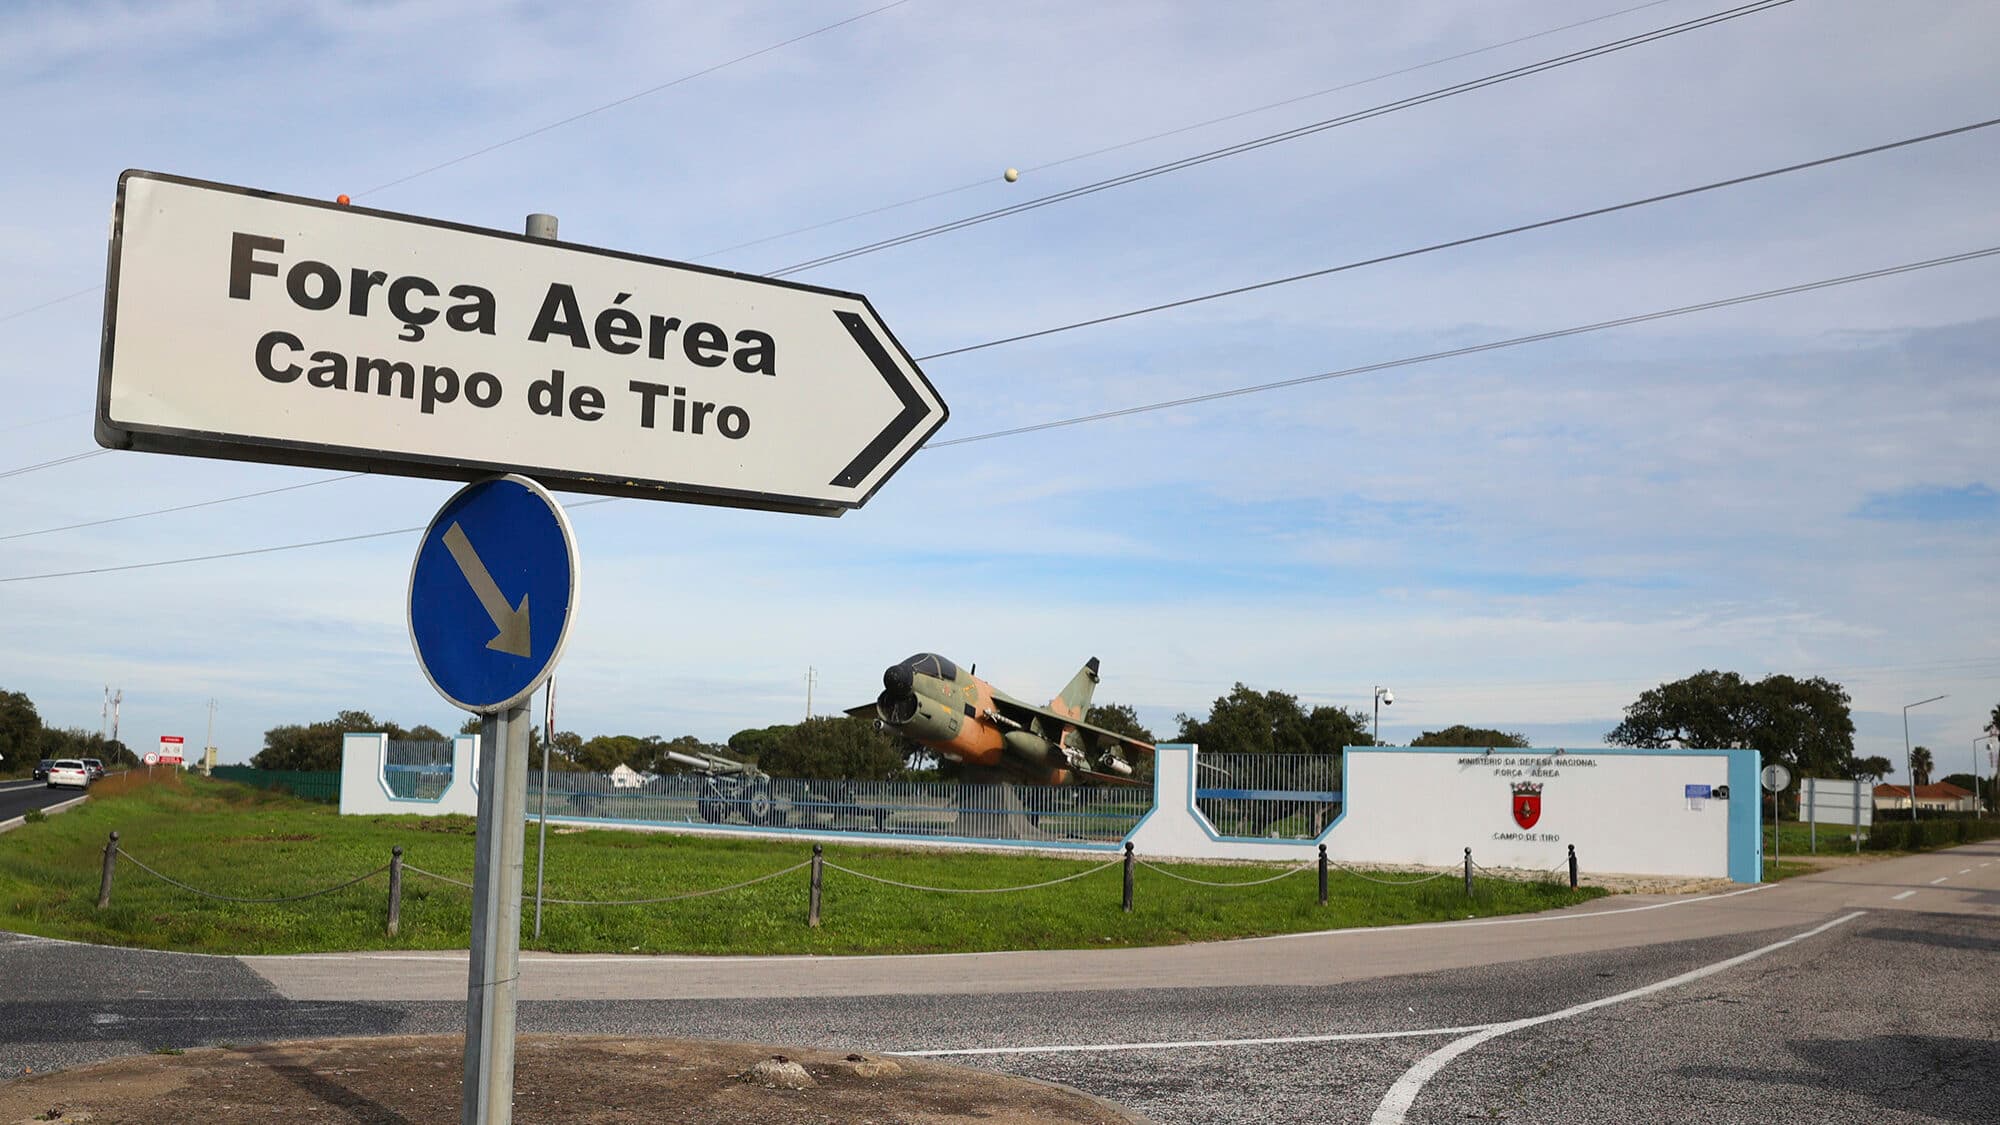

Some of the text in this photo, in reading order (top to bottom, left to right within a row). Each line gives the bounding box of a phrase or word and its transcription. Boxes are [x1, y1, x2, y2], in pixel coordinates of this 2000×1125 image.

[229, 232, 776, 376] Força Aérea
[256, 332, 750, 439] Campo de Tiro
[1505, 758, 1516, 766] DA
[1519, 758, 1553, 767] DEFESA
[1556, 759, 1598, 767] NACIONAL
[1493, 832, 1560, 842] CAMPO DE TIRO
